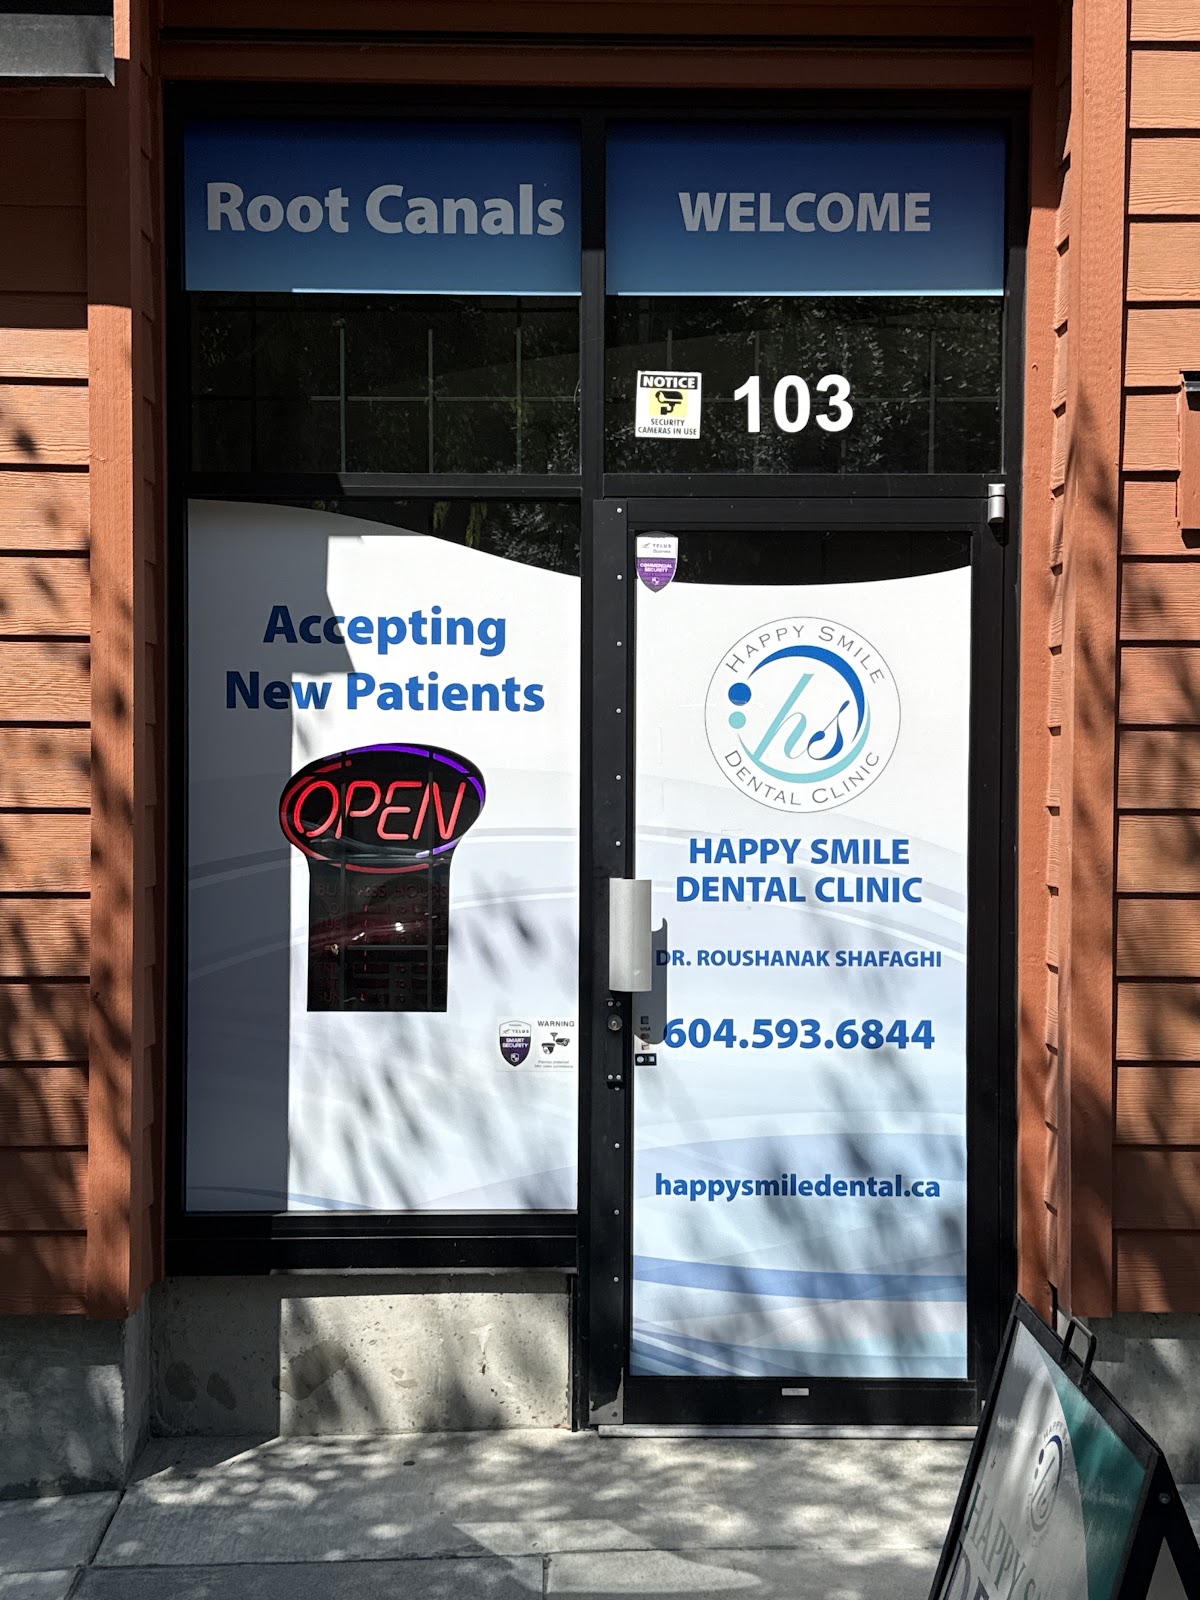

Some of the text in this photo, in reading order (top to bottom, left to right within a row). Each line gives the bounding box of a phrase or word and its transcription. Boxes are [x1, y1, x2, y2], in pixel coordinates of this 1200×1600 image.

[206, 182, 566, 236] Root Canals
[678, 191, 932, 234] WELCOME
[643, 374, 696, 389] NOTICE
[650, 418, 685, 427] SECURITY
[734, 374, 854, 433] 103
[638, 426, 697, 436] CAMERAS IN USE
[262, 605, 507, 657] Accepting
[725, 625, 885, 684] HAPPY SMILE
[225, 671, 545, 713] New Patients
[724, 750, 880, 806] DENTAL CLINIC
[293, 780, 467, 840] OPEN
[689, 838, 910, 865] HAPPY SMILE
[676, 876, 923, 904] DENTAL CLINIC
[655, 950, 942, 968] DR. ROUSHANAK SHAFAGHI
[664, 1018, 935, 1050] 604.593.6844
[655, 1173, 941, 1202] happysmiledental.ca
[964, 1481, 1026, 1600] HAPPY
